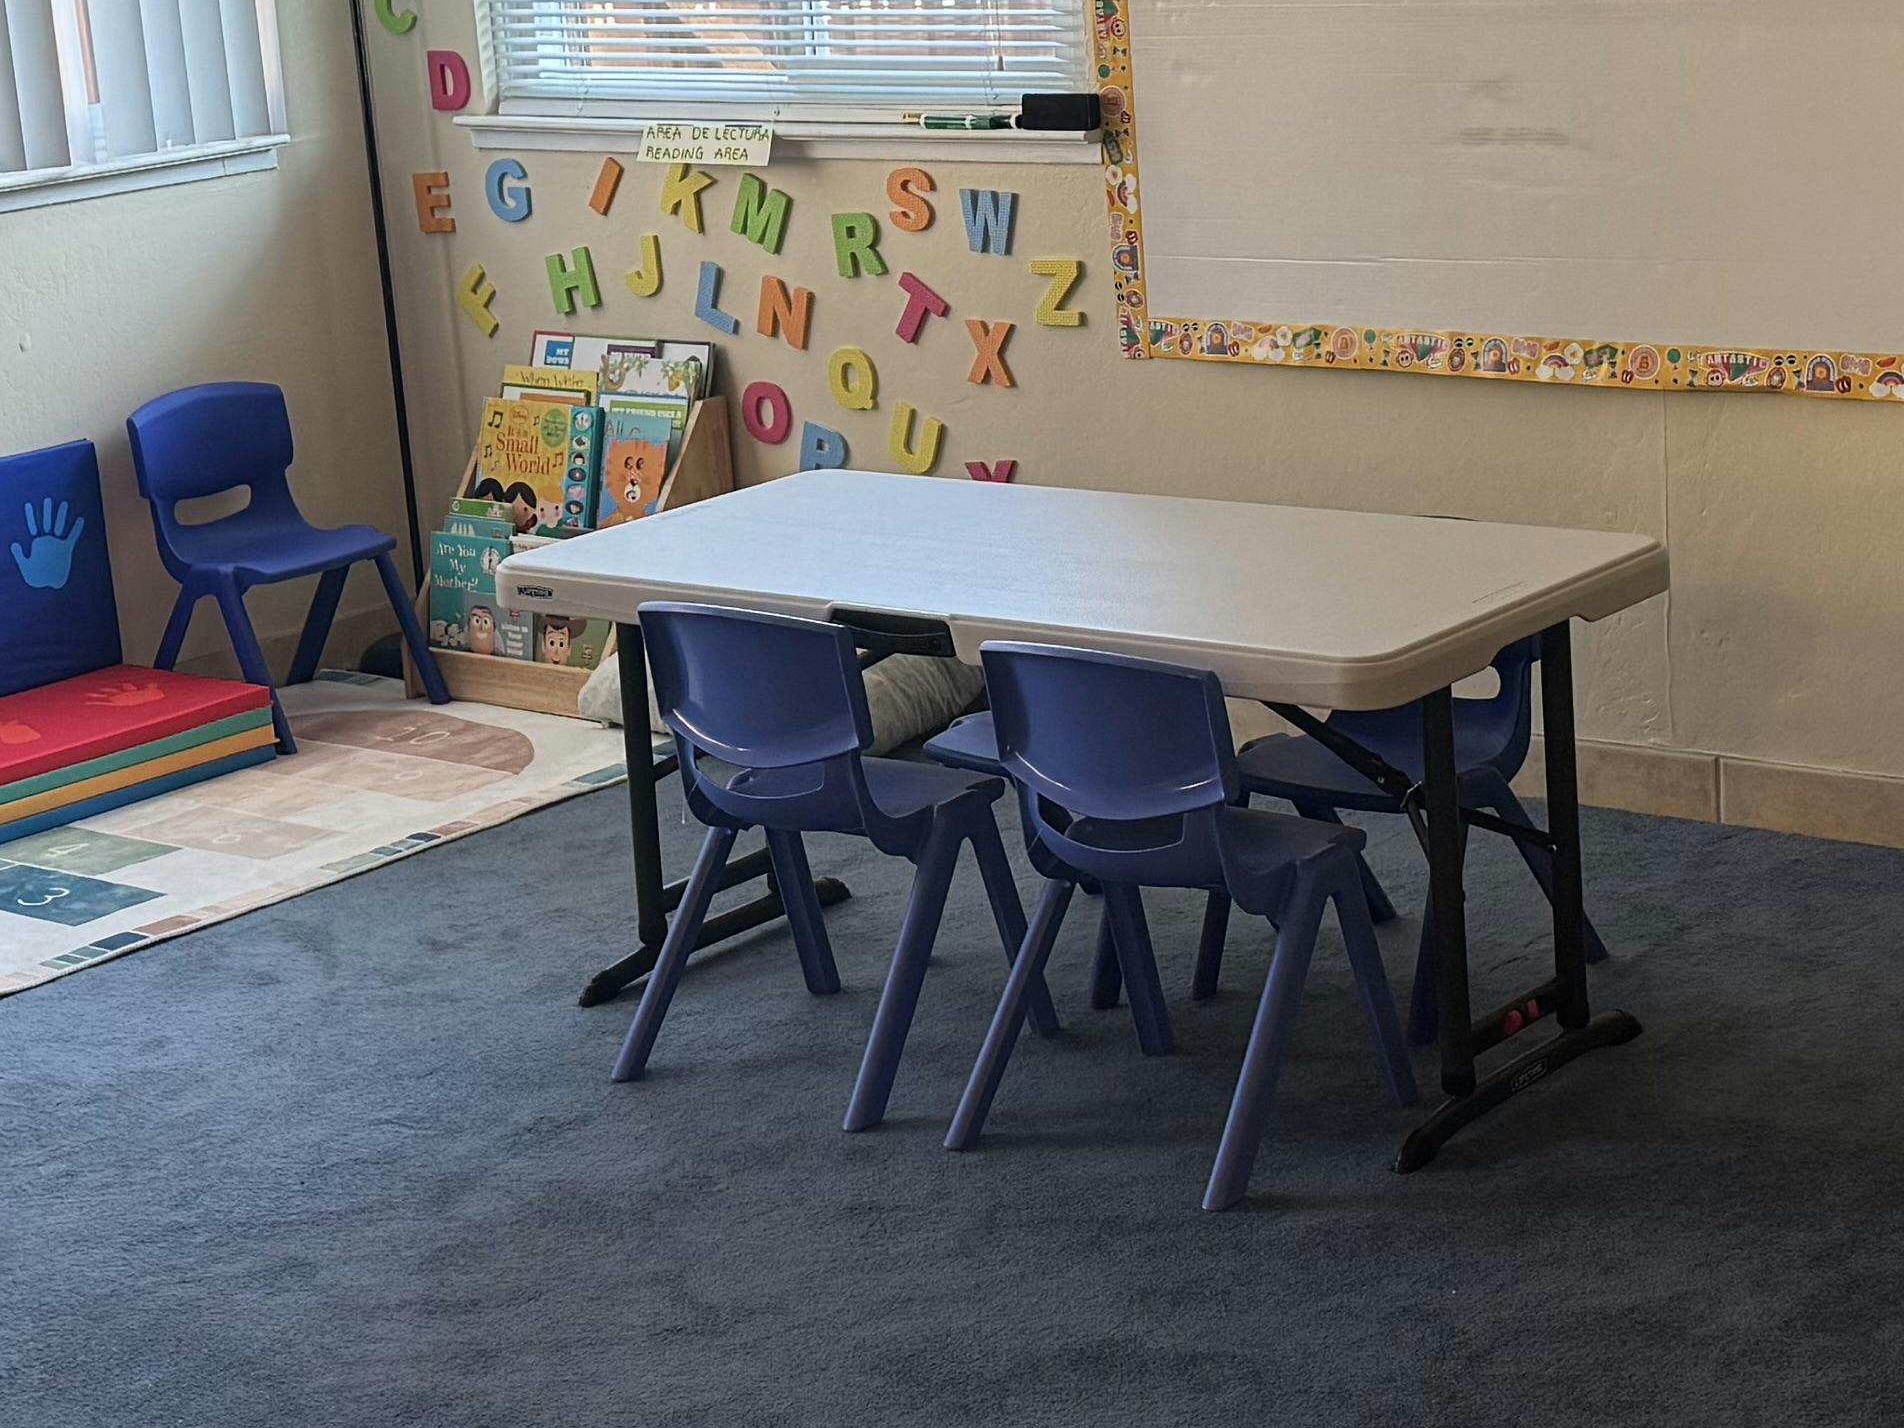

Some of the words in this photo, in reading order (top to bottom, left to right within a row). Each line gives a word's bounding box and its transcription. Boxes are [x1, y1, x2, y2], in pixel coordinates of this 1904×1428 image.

[427, 50, 471, 111] D
[646, 146, 703, 160] READING
[714, 147, 748, 161] AREA
[692, 126, 710, 140] DE
[716, 127, 769, 141] LECTURA
[412, 171, 456, 234] E
[485, 158, 532, 222] G
[588, 156, 625, 216] I
[660, 163, 714, 233] K
[730, 173, 793, 254] M
[886, 167, 937, 231] S
[832, 212, 887, 277] R
[959, 188, 1017, 255] W
[545, 245, 601, 314] H
[625, 234, 664, 297] J
[695, 260, 738, 335] L
[1030, 259, 1086, 326] Z
[456, 263, 499, 338] F
[757, 276, 815, 349] N
[896, 271, 948, 344] T
[827, 348, 877, 409] Q
[965, 319, 1016, 387] X
[496, 433, 539, 454] Small
[742, 381, 791, 444] O
[890, 402, 945, 474] U
[506, 452, 550, 475] World
[800, 420, 849, 473] P
[457, 544, 476, 557] You
[16, 886, 70, 908] 3
